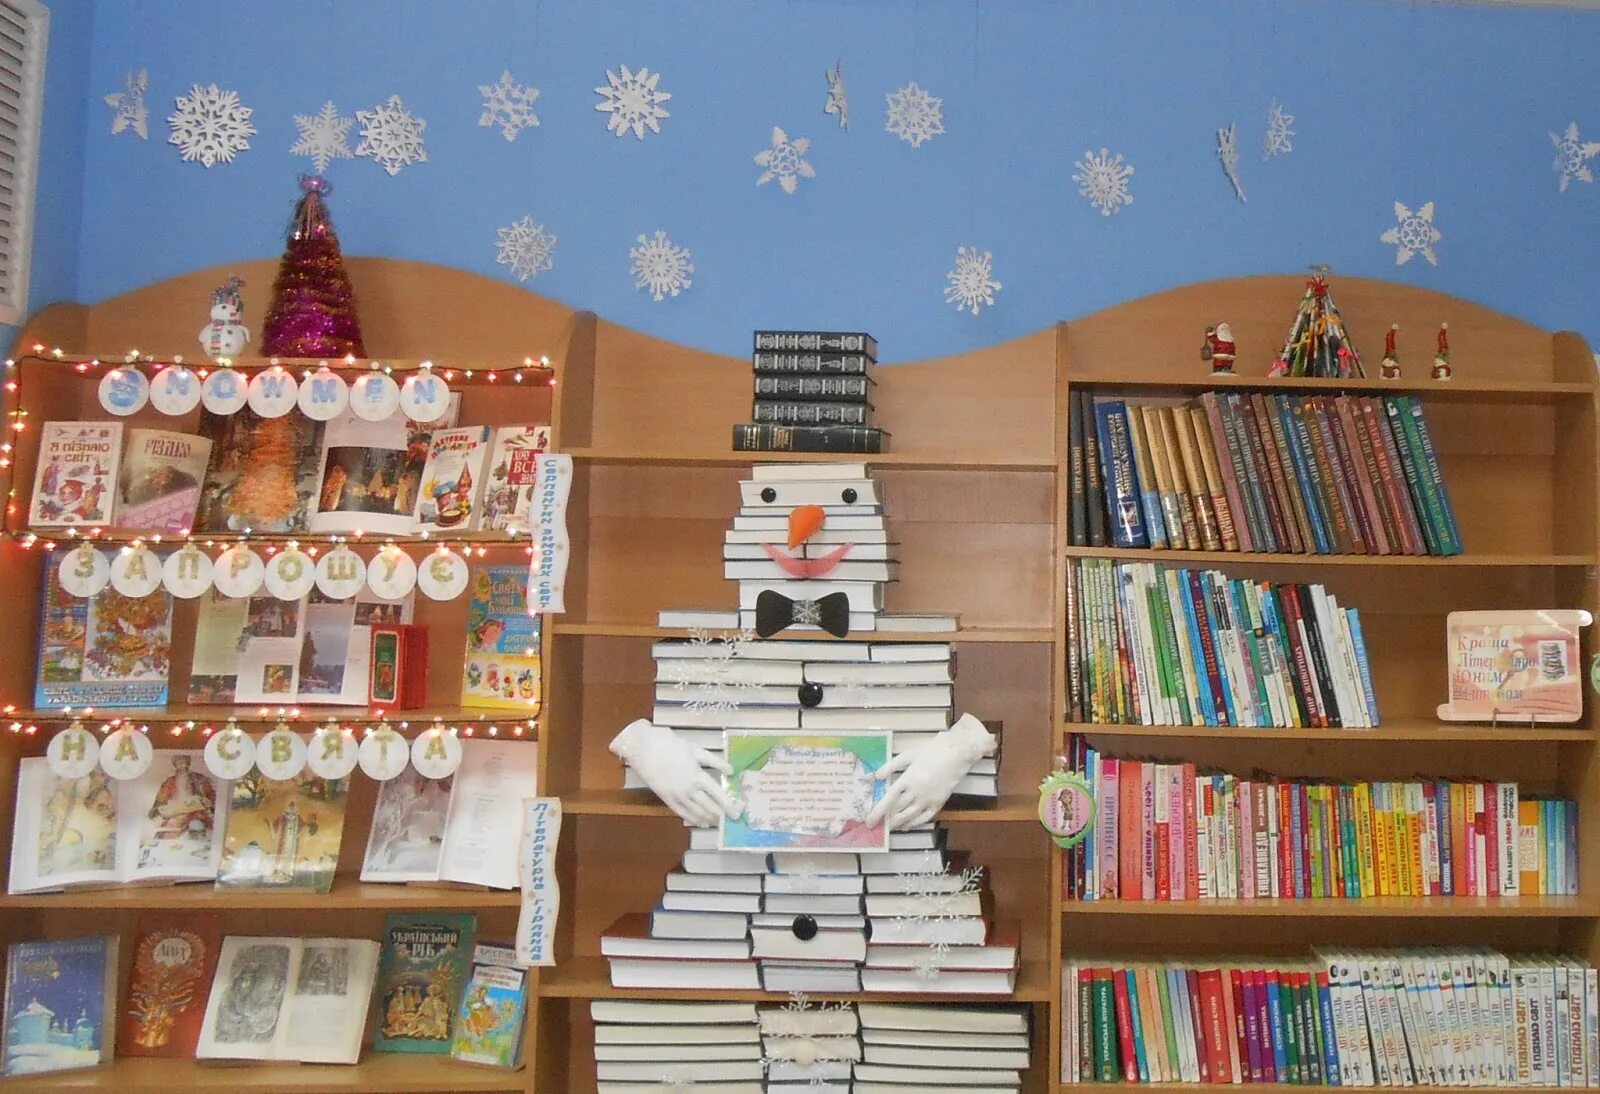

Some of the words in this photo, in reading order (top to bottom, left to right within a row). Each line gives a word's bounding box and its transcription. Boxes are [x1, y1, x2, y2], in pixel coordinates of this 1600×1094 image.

[1232, 455, 1247, 484] МИРА
[1268, 453, 1282, 482] МИРА
[1280, 451, 1295, 481] МИРА
[1306, 459, 1321, 484] МИРА
[1330, 457, 1345, 484] МИРА
[1367, 457, 1382, 484] МИРА
[1376, 452, 1392, 482] МИРА
[1403, 458, 1419, 484] МИРА
[1293, 645, 1312, 692] ЖИВОТНЫХ
[1305, 694, 1317, 713] МИР
[61, 734, 139, 762] НА
[1256, 831, 1269, 895] ЕНЦИКЛОПЕДІЯ
[1273, 1000, 1281, 1027] УКРАЇНИ
[1295, 1005, 1303, 1023] МОВА
[1305, 1000, 1313, 1017] МОВА
[1516, 999, 1526, 1023] СВІТ
[1530, 999, 1539, 1021] СВІТ
[1545, 998, 1553, 1019] СВІТ
[1571, 995, 1580, 1020] СВІТ
[1261, 1007, 1269, 1048] МАТЕМАТИКА
[1286, 1014, 1294, 1043] БІОЛОГІЯ
[1325, 1020, 1335, 1056] УКРАЇНСЬКА
[1518, 1027, 1528, 1069] ПІЗНАЮ
[1532, 1023, 1541, 1062] ПІЗНАЮ
[1572, 1021, 1582, 1065] ПІЗНАЮ
[1573, 1068, 1582, 1076] Я
